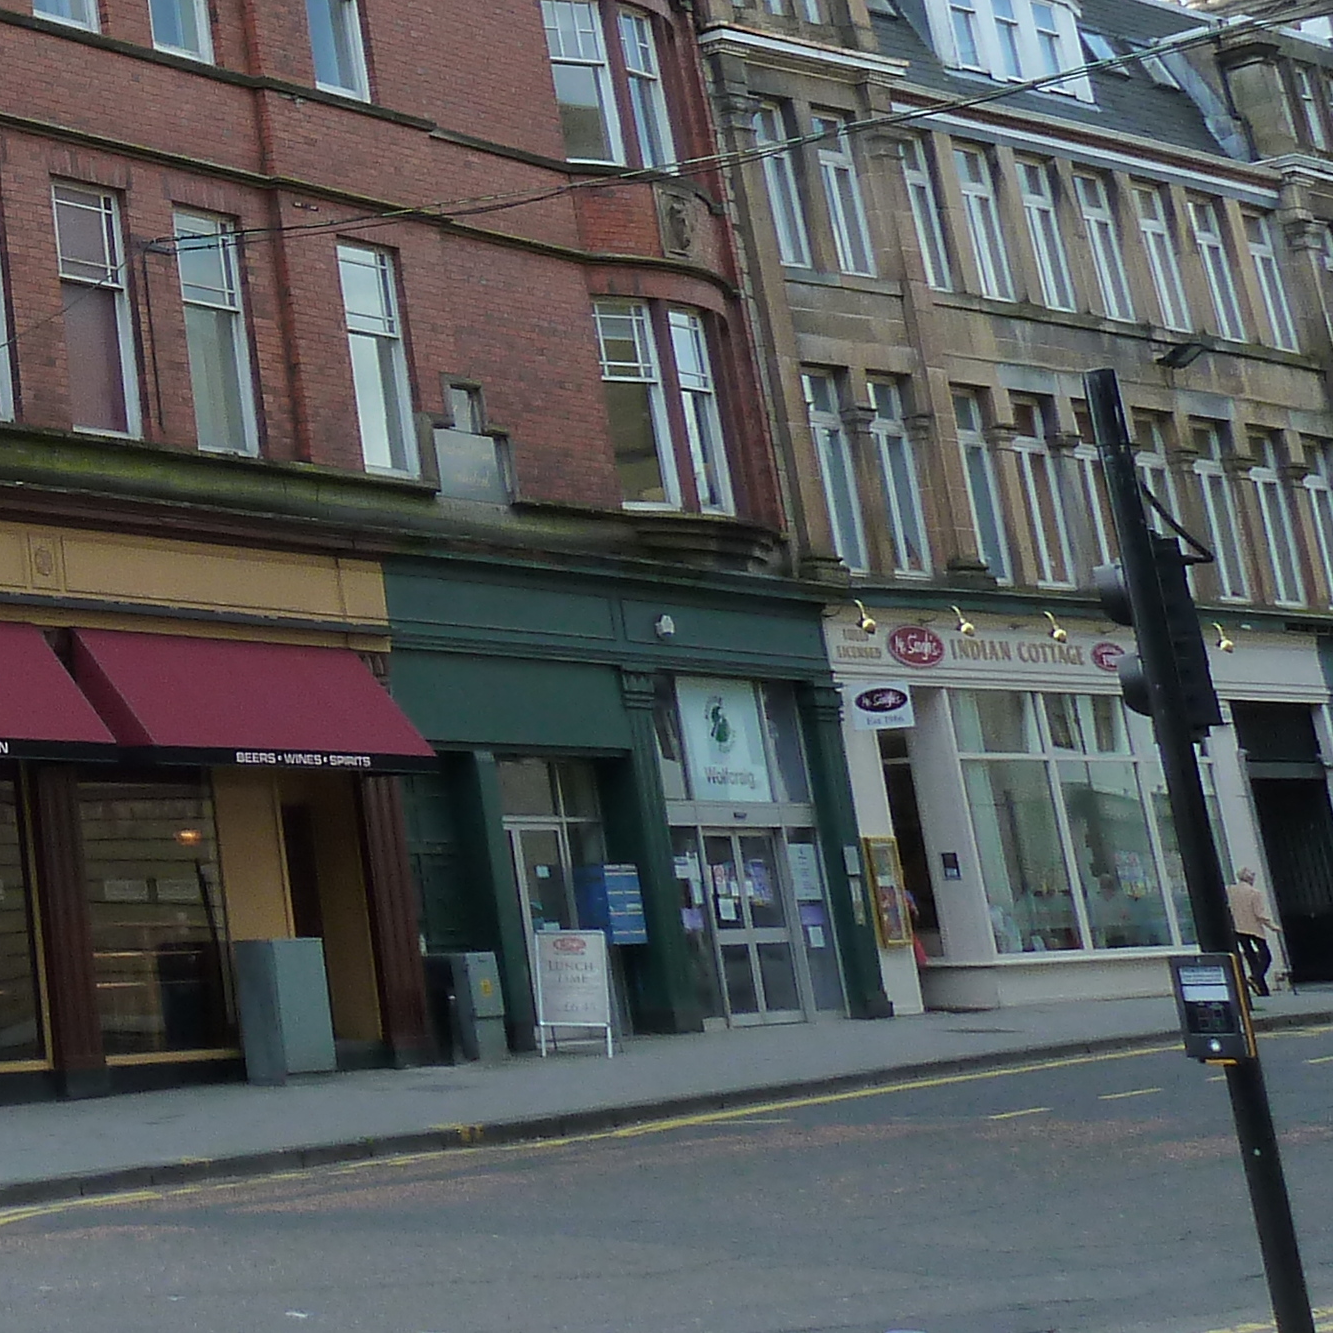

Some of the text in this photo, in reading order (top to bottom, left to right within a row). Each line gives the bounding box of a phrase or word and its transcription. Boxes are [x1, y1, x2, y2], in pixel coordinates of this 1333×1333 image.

[949, 638, 1012, 662] INDIAN
[1016, 641, 1085, 666] COTTAGE
[236, 751, 372, 767] BEERS WINES SPIRITS
